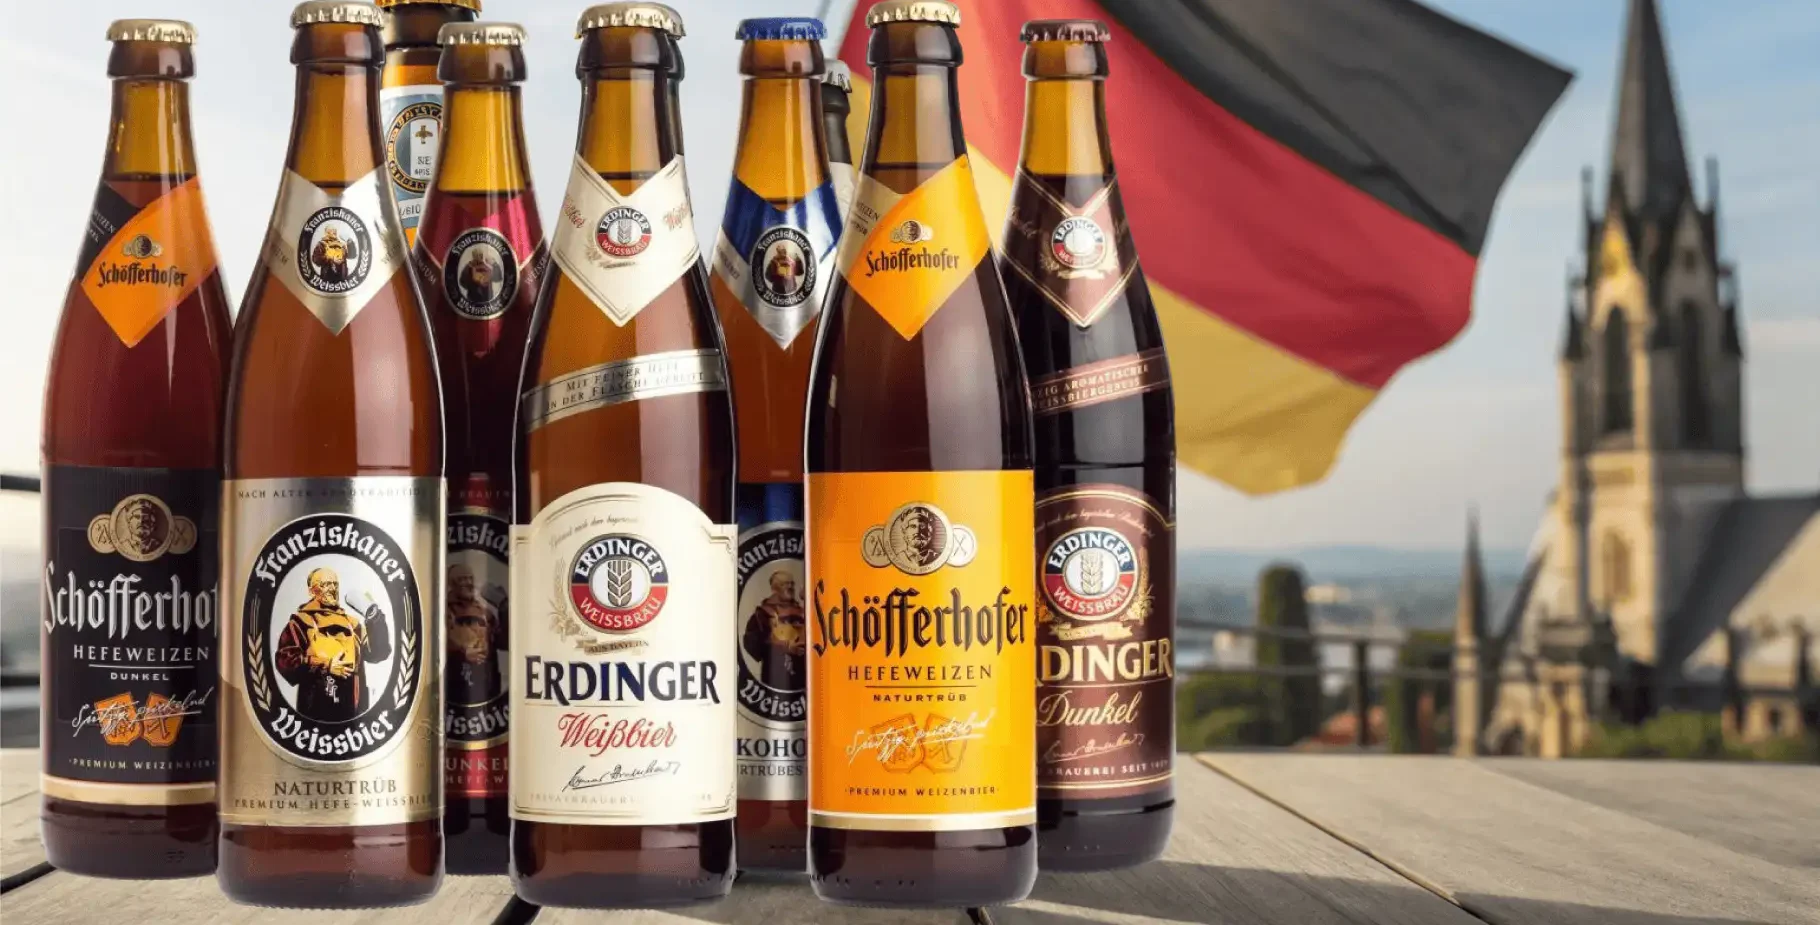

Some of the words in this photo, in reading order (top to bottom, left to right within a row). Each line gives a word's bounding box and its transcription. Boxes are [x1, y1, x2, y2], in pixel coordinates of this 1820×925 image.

[600, 208, 650, 230] ERDINGER
[96, 261, 188, 288] Schöfferhofer
[865, 247, 960, 277] Schöfferhofer
[310, 273, 360, 293] Weissbier
[254, 521, 406, 589] Franziskaner
[574, 538, 664, 578] ERDINGER
[1048, 531, 1132, 569] ERDINGER
[580, 596, 663, 629] WEISSBRÄU
[1053, 583, 1129, 615] WEISSBRÄU
[812, 578, 1029, 659] Schöfferhofer
[73, 644, 210, 662] HEFEWEIZEN
[1036, 637, 1173, 687] DINGER
[110, 672, 169, 682] DUNKEL
[525, 655, 721, 706] ERDINGER
[848, 664, 993, 682] HEFEWEIZEN
[873, 691, 967, 703] NATURTRÜB
[1036, 689, 1143, 728] Dunkel
[270, 706, 395, 756] Weissbier
[557, 711, 678, 758] Weißbier
[234, 797, 300, 810] PREMIUM
[273, 778, 398, 797] NATURTRÜB
